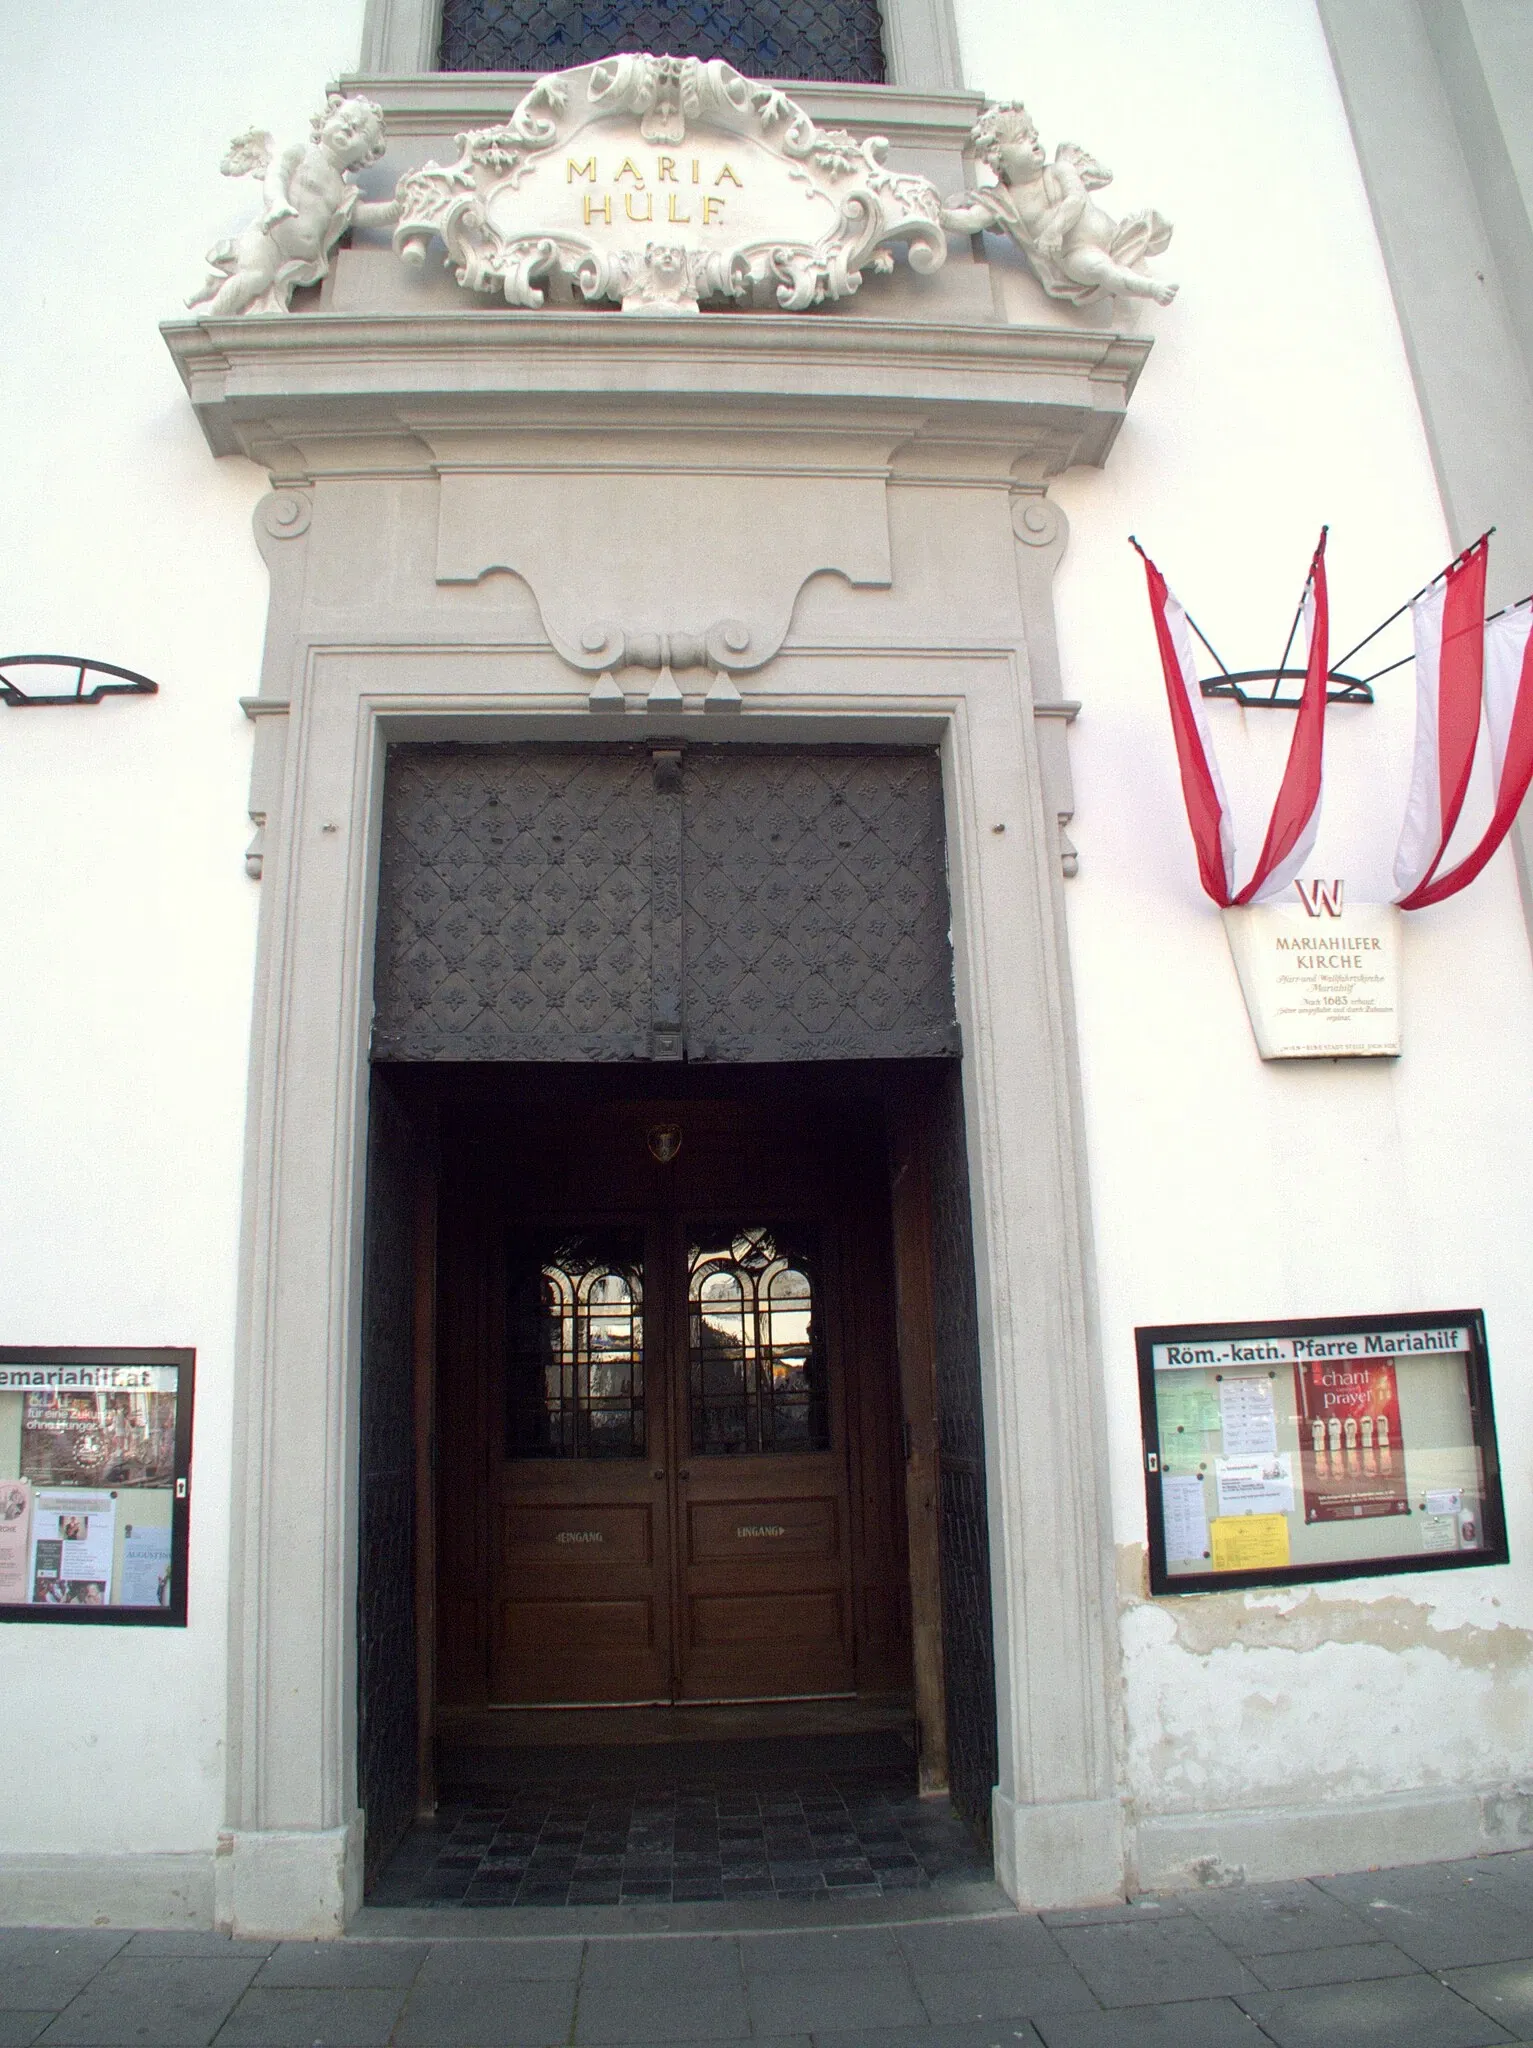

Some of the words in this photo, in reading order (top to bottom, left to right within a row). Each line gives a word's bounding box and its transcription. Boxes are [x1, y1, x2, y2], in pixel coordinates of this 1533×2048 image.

[567, 156, 743, 188] MARIA
[1294, 879, 1344, 917] W
[1276, 937, 1382, 950] MARIAHILFER
[1297, 955, 1363, 968] KIRCHE
[1323, 995, 1348, 1006] 1683
[1167, 1343, 1285, 1364] Röm.-kath.
[1292, 1340, 1358, 1357] Pfarre
[1365, 1331, 1458, 1353] Mariahilf
[1322, 1370, 1372, 1386] chant
[1324, 1390, 1372, 1408] prayer
[561, 1532, 602, 1542] EINGANG
[737, 1526, 778, 1537] EINGANG
